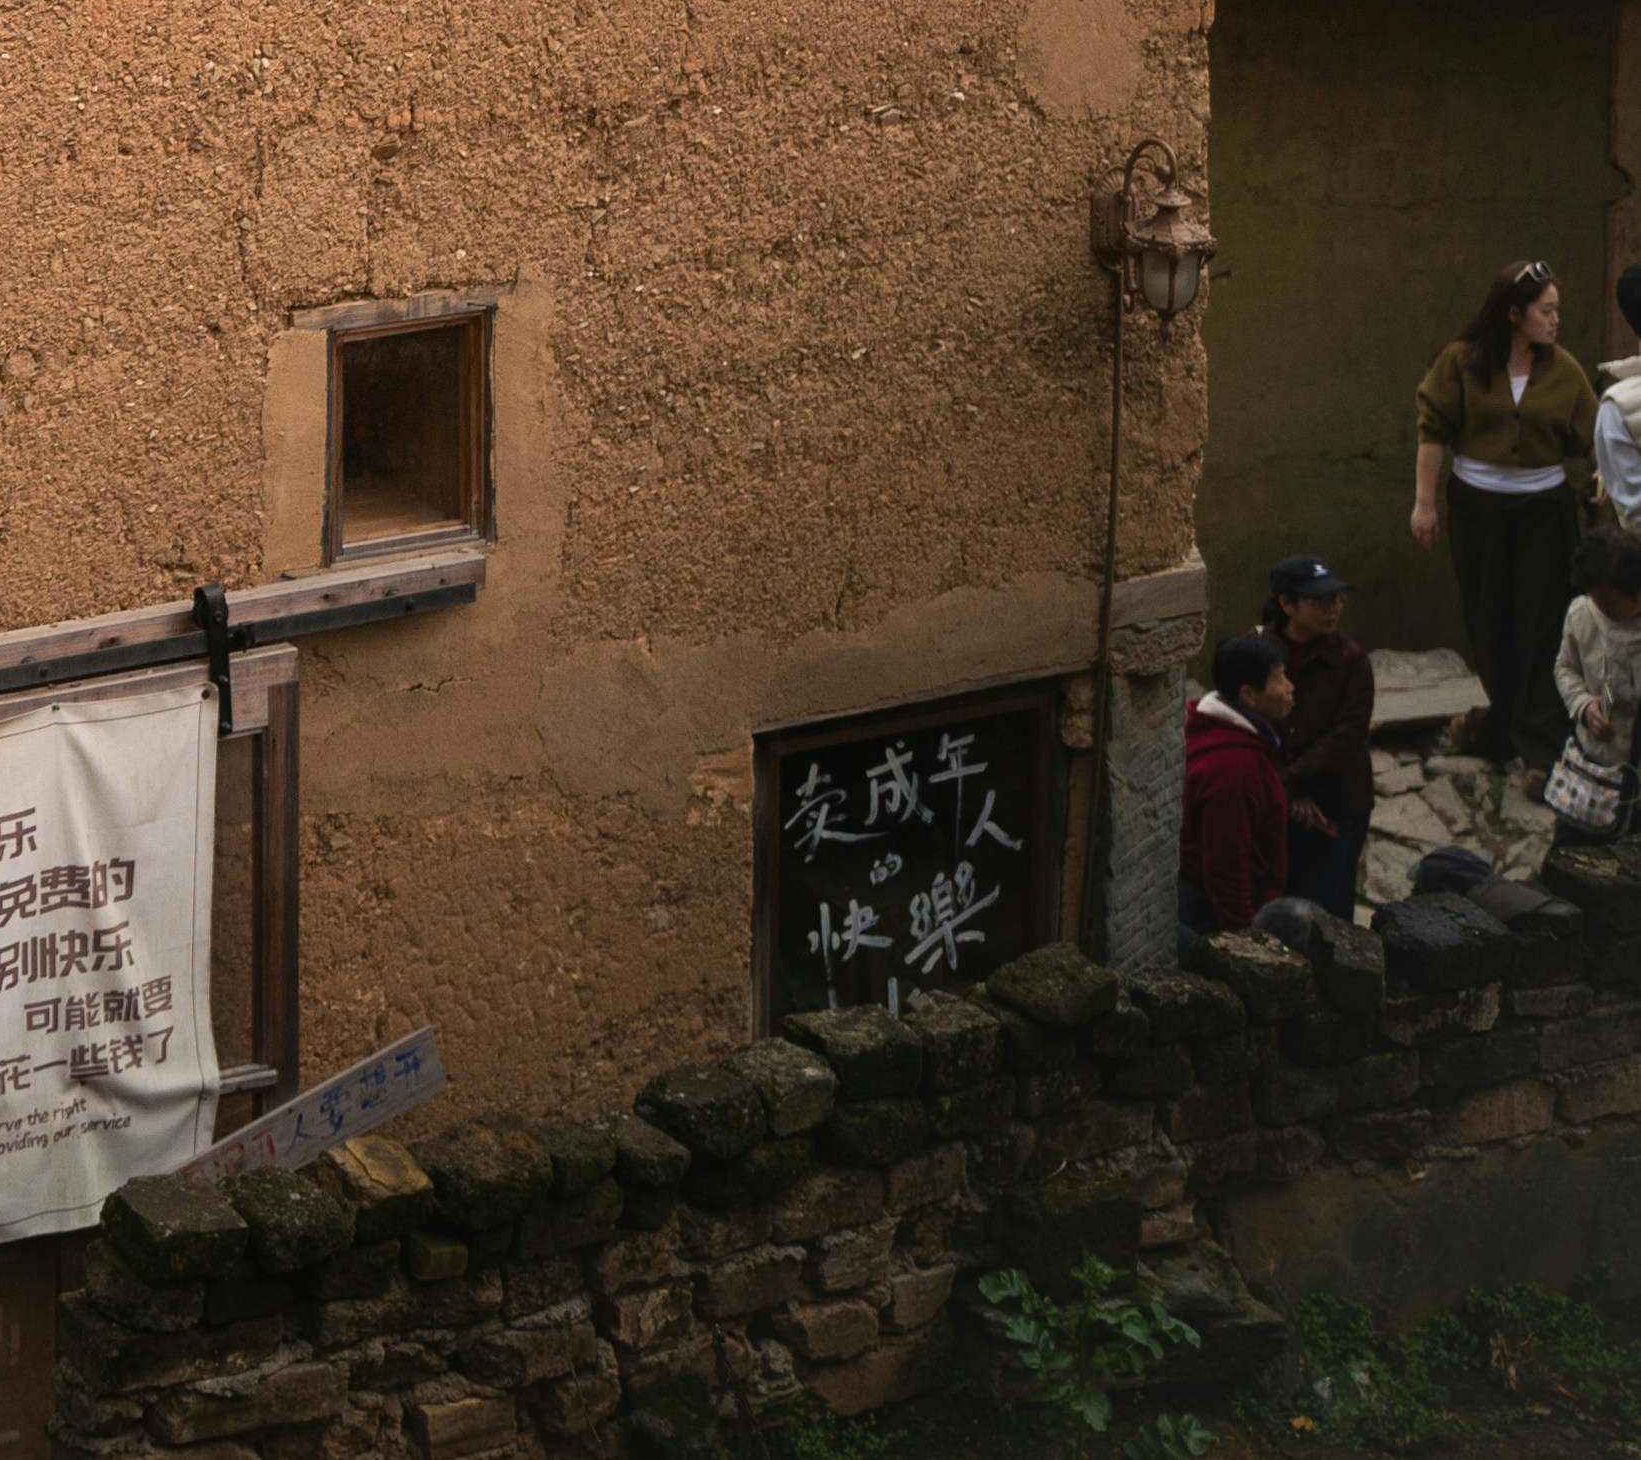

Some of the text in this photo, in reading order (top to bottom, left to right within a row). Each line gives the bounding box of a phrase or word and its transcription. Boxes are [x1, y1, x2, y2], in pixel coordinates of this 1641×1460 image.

[24, 974, 174, 1034] 可能就要
[26, 1108, 49, 1126] the
[53, 1097, 87, 1122] right
[53, 1124, 76, 1143] our
[80, 1113, 131, 1133] service
